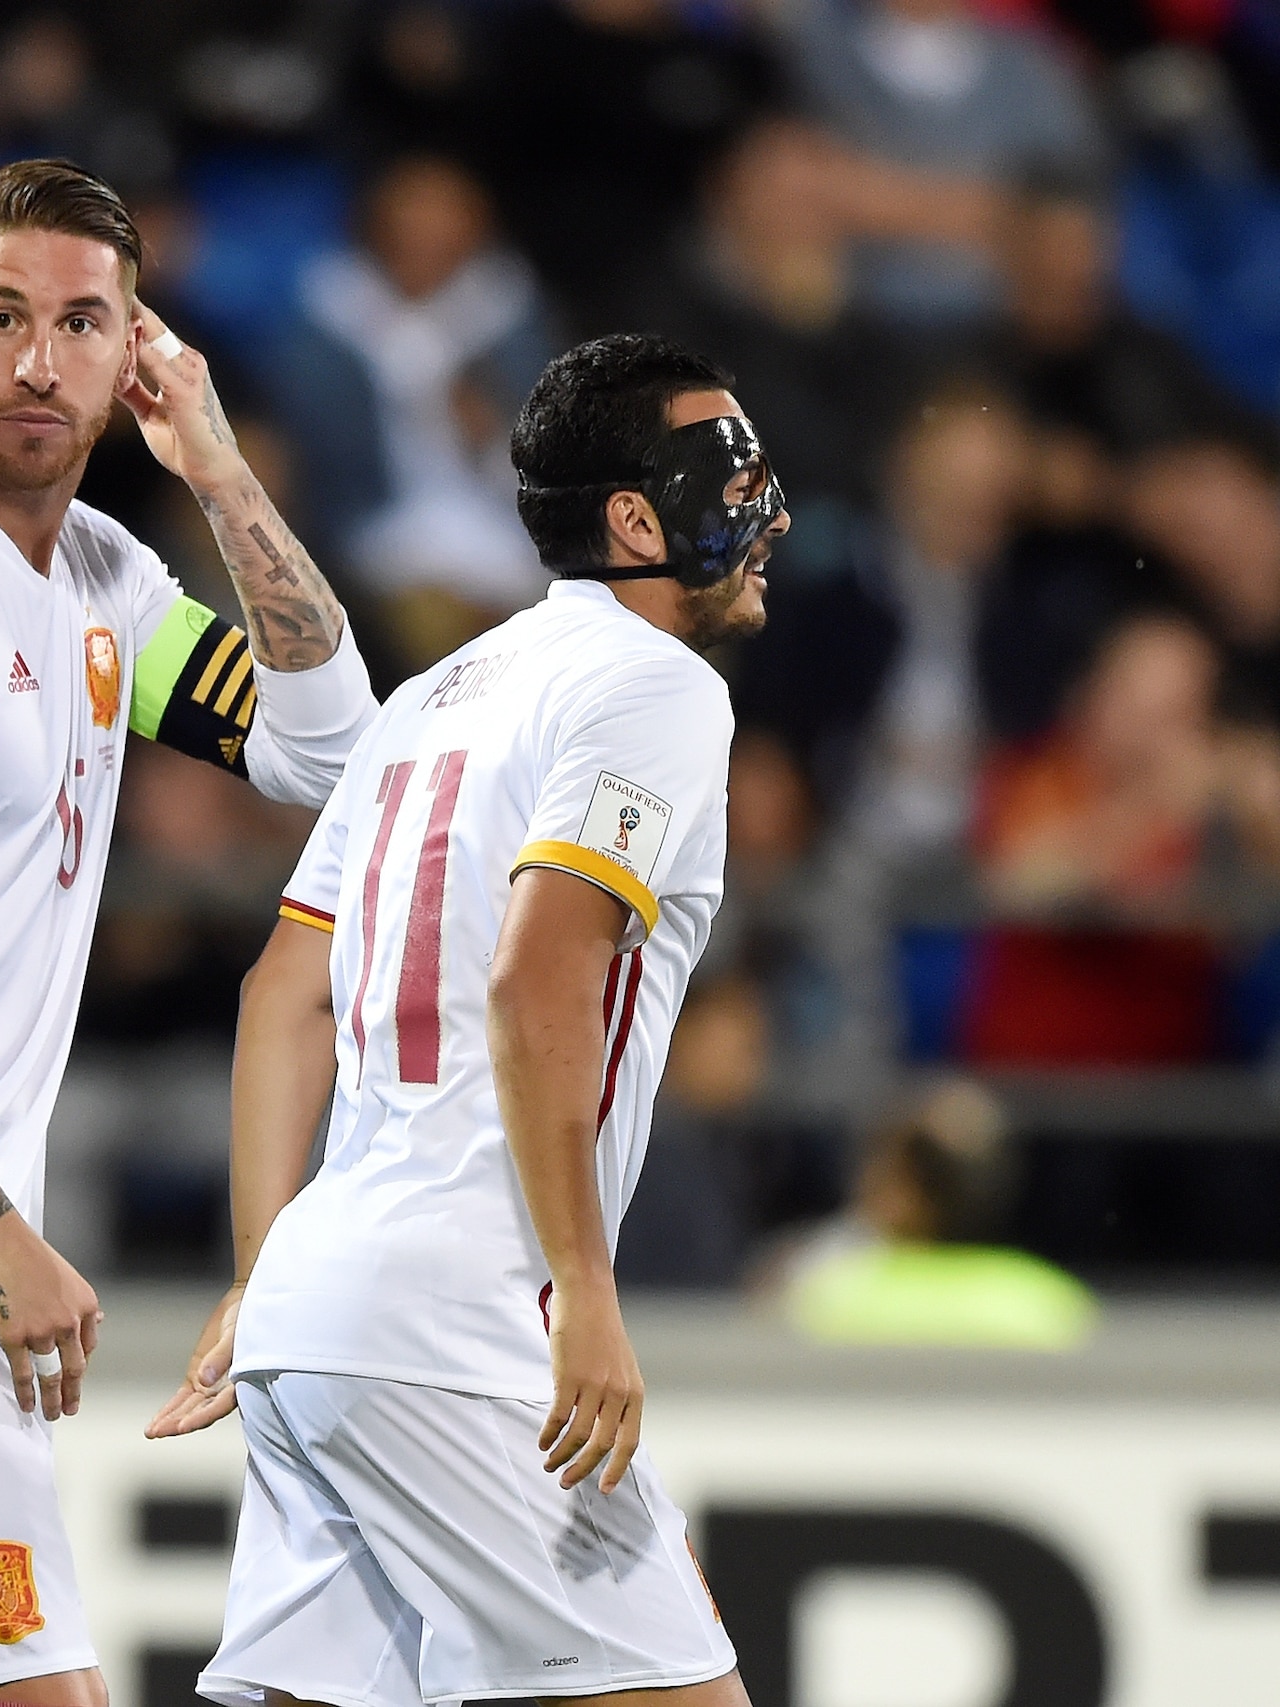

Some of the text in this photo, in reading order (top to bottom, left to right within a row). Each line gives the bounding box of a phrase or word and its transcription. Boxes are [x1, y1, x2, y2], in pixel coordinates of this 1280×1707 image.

[8, 677, 40, 693] adidas
[602, 778, 667, 818] QUALIFIERS
[352, 749, 469, 1091] 11
[542, 1656, 579, 1667] adizero
